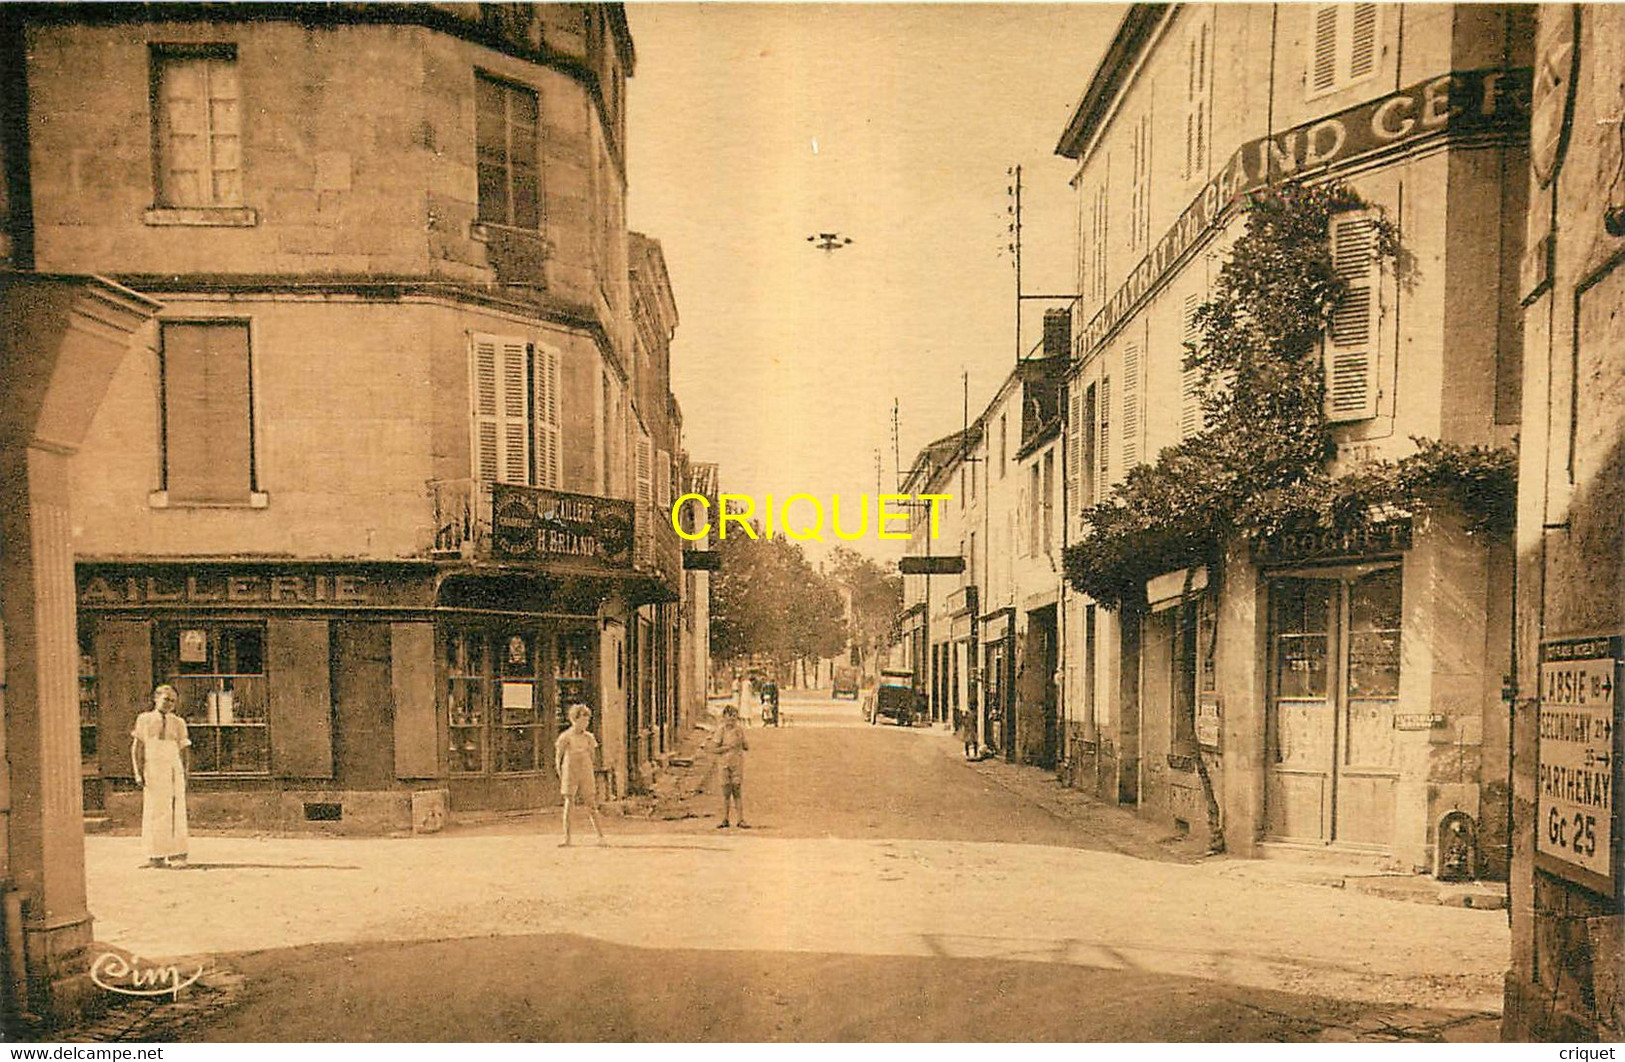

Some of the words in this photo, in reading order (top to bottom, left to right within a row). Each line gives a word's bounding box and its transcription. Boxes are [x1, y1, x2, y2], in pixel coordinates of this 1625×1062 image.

[1203, 119, 1347, 222] GRAND
[82, 575, 369, 602] AILLERIE
[1540, 711, 1592, 744] SECONDIGNY
[1540, 763, 1610, 809] PARTHENAY
[1573, 813, 1596, 858] 25
